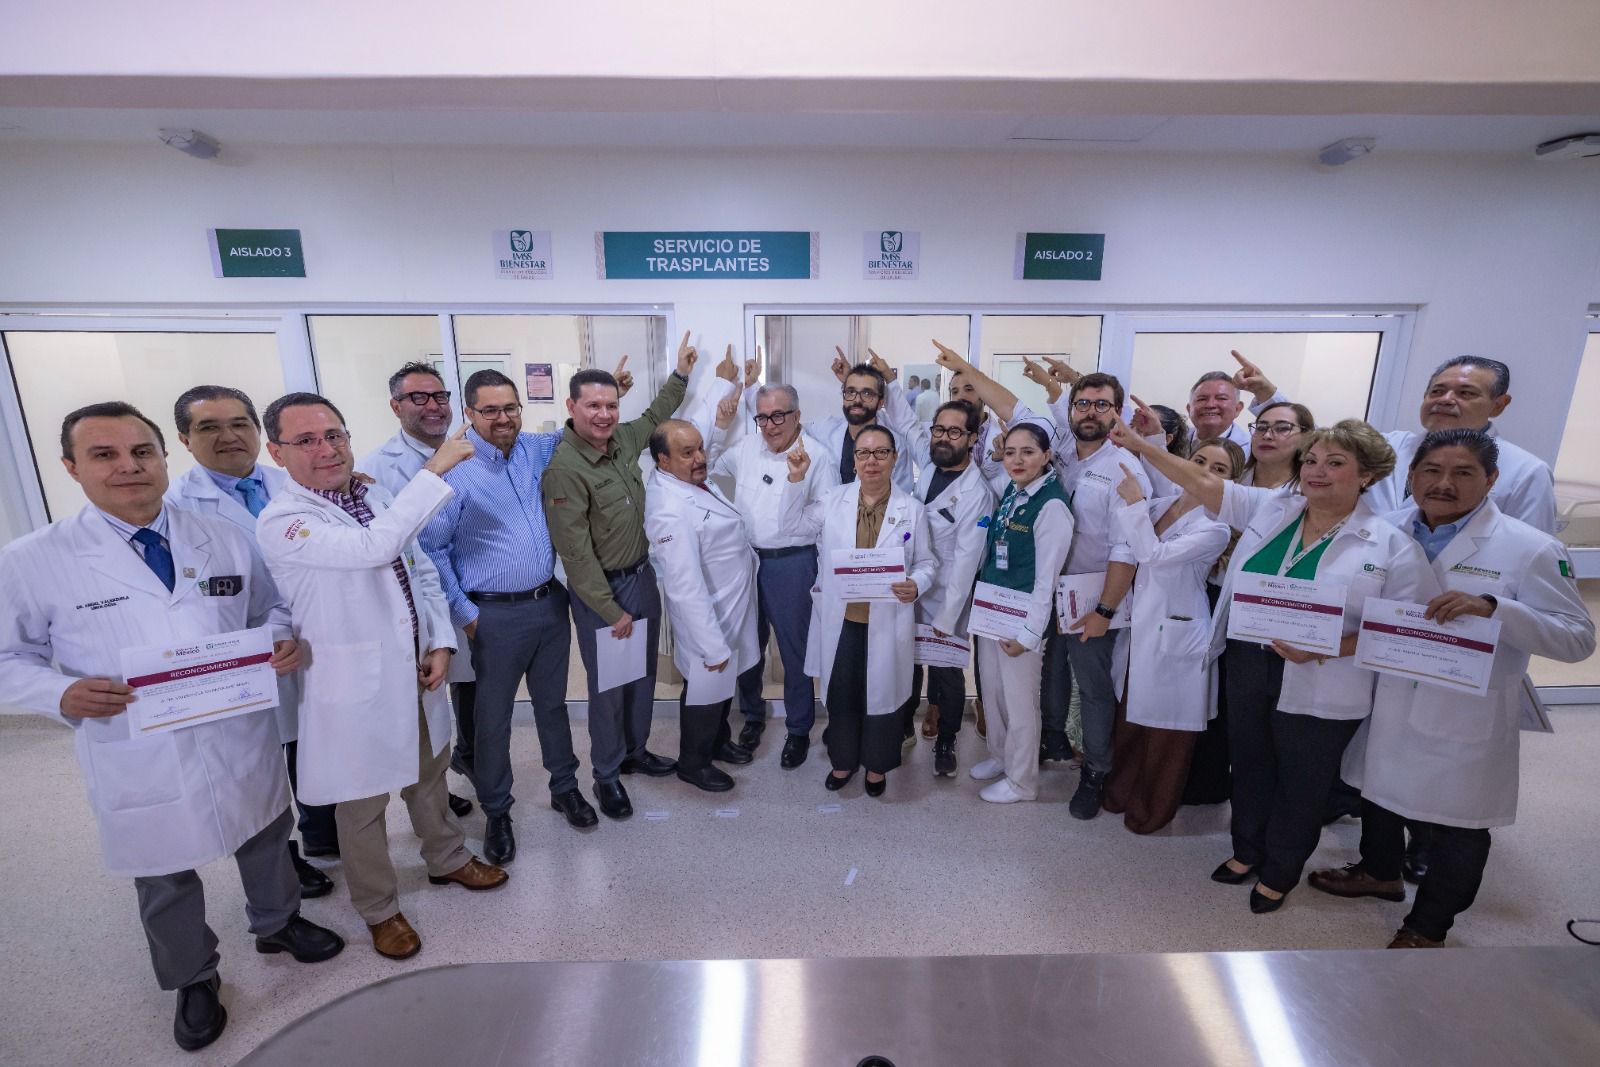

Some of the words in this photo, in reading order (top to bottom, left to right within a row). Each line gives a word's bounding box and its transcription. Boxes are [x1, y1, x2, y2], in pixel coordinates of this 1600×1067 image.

[653, 239, 734, 253] SERVICIO
[738, 239, 762, 253] DE
[229, 247, 282, 257] AISLADO
[284, 247, 292, 257] 3
[512, 252, 533, 260] IMSS
[881, 252, 901, 260] IMSS
[1034, 250, 1084, 260] AISLADO
[1086, 251, 1093, 260] 2
[499, 259, 546, 269] BIENESTAR
[646, 257, 770, 272] TRASPLANTES
[868, 260, 913, 269] BIENESTAR
[1260, 598, 1313, 610] RECONOCIMIENTO
[1396, 627, 1458, 644] RECONOCIMIENTO
[170, 660, 239, 678] RECONOCIMIENTO
